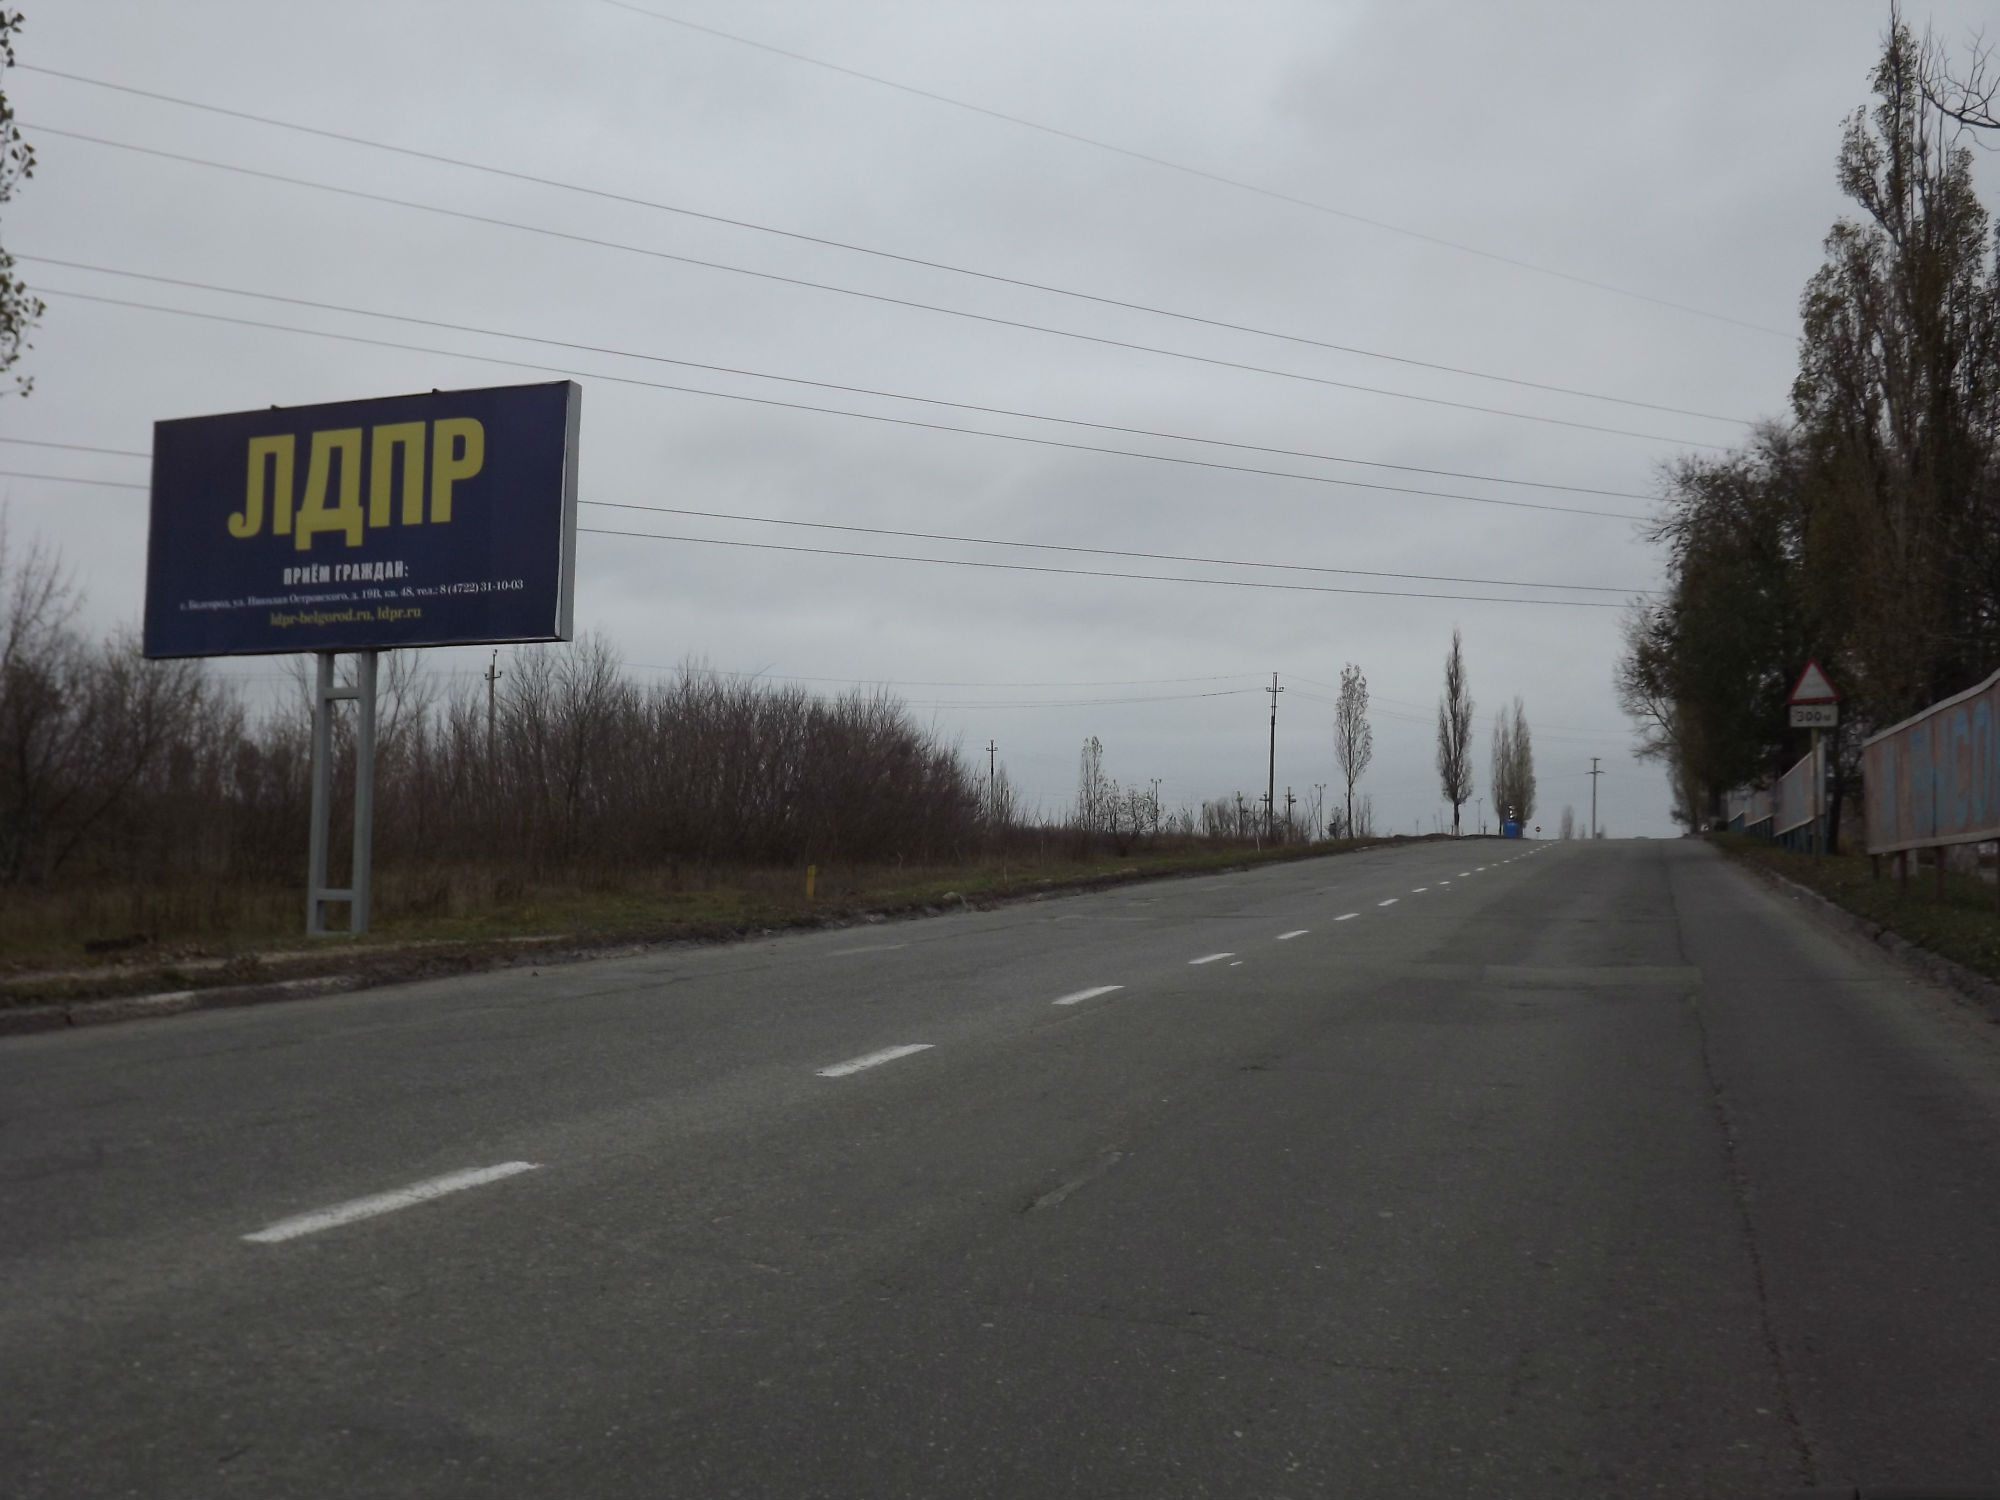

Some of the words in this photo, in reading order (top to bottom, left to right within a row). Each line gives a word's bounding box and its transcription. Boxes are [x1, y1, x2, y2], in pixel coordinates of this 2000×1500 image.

[227, 417, 486, 551] ЛДПР
[283, 563, 330, 586] ПРИЁМ
[335, 560, 409, 582] ГРАЖДАН:
[447, 581, 479, 595] (4722)
[480, 579, 524, 591] 31-10-03
[377, 606, 422, 621] ldpr.ru
[1796, 711, 1822, 722] 300
